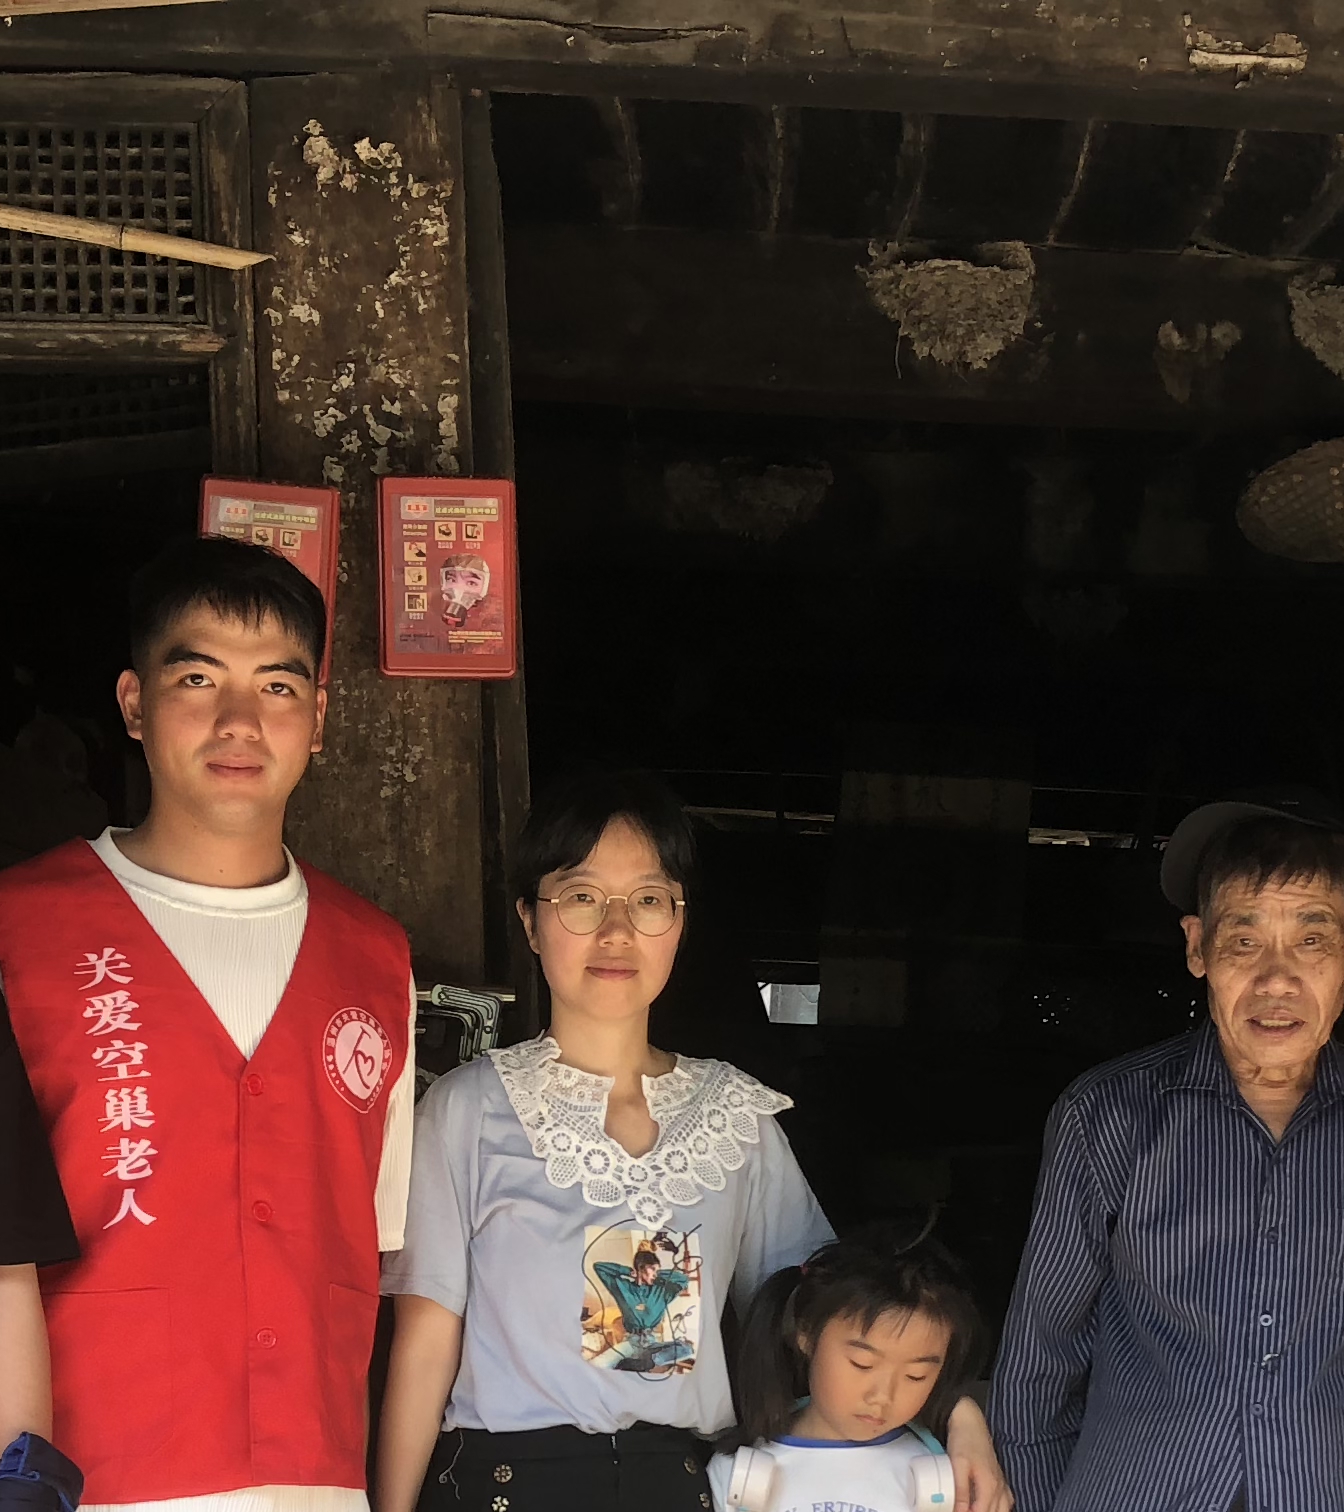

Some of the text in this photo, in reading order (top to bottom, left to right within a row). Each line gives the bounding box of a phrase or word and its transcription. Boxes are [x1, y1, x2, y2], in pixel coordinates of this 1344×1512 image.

[74, 947, 158, 1230] 关爱空巢老人
